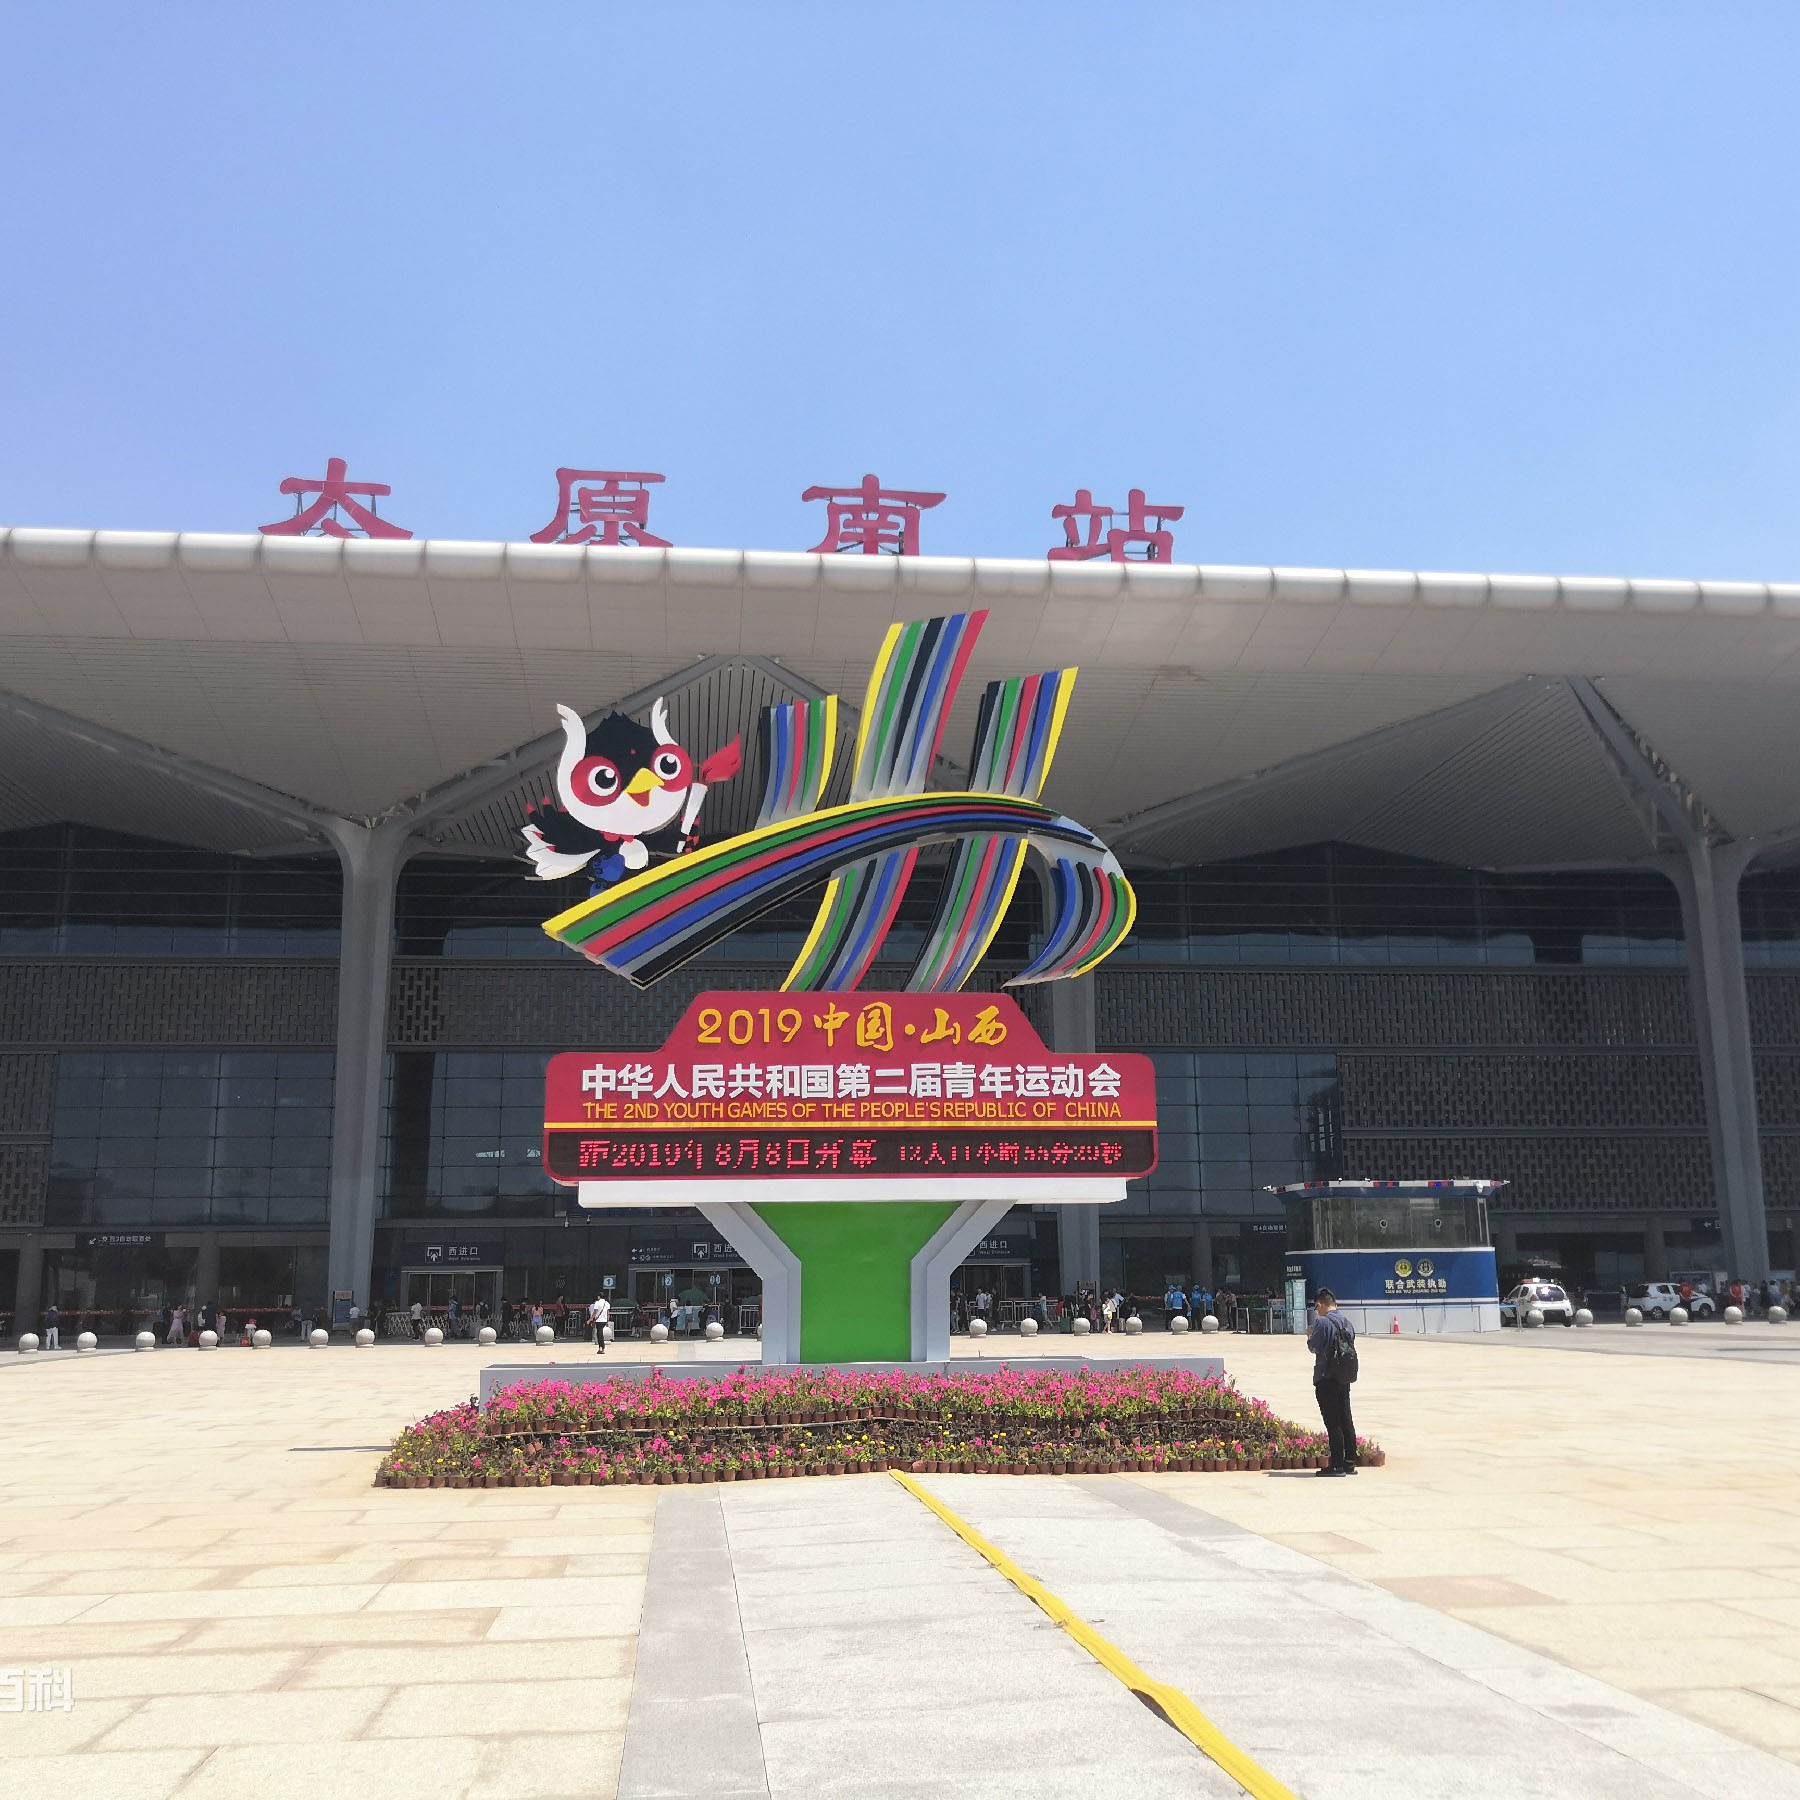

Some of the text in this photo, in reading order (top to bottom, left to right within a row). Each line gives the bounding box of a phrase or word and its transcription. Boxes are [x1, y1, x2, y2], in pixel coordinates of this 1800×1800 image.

[258, 458, 1184, 564] 太原南站
[697, 1008, 802, 1045] 2019
[581, 1061, 1122, 1101] 中华人民共和国第二届青年运动会
[582, 1101, 1122, 1119] THE 2ND YOUTH GAMES OF THE PEOPLE'S REPUBLIC OF CHINA
[448, 1246, 479, 1256] 西进口
[713, 1243, 735, 1253] 西进
[979, 1240, 1008, 1249] 西进口
[1384, 1278, 1447, 1290] 联合武装执勤
